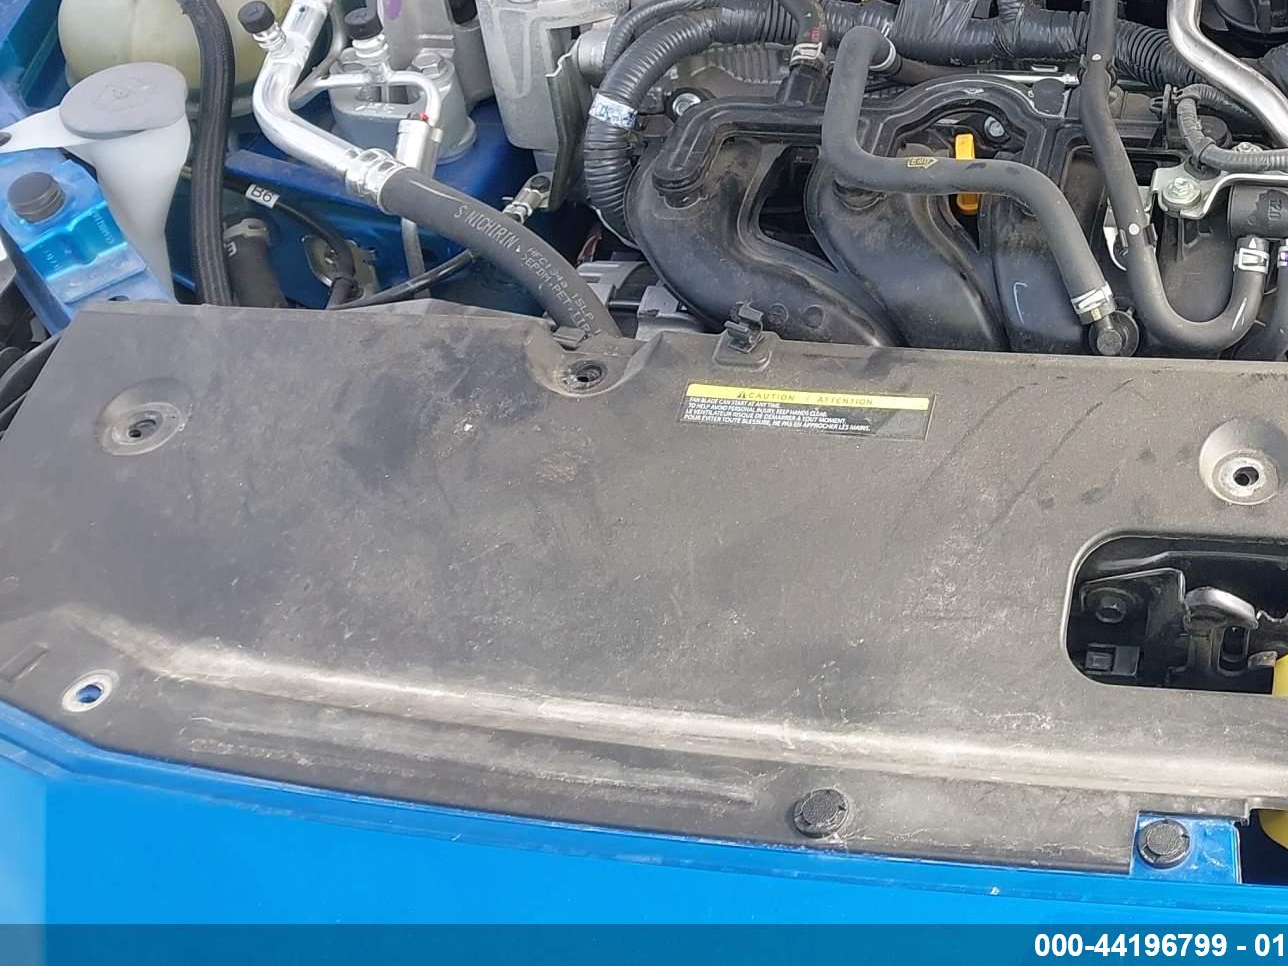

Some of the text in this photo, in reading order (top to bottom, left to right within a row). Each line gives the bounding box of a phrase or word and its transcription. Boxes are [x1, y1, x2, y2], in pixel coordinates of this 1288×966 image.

[464, 209, 520, 252] NICHIRIN
[748, 392, 796, 402] CAUTION
[816, 396, 873, 405] ATTENTION
